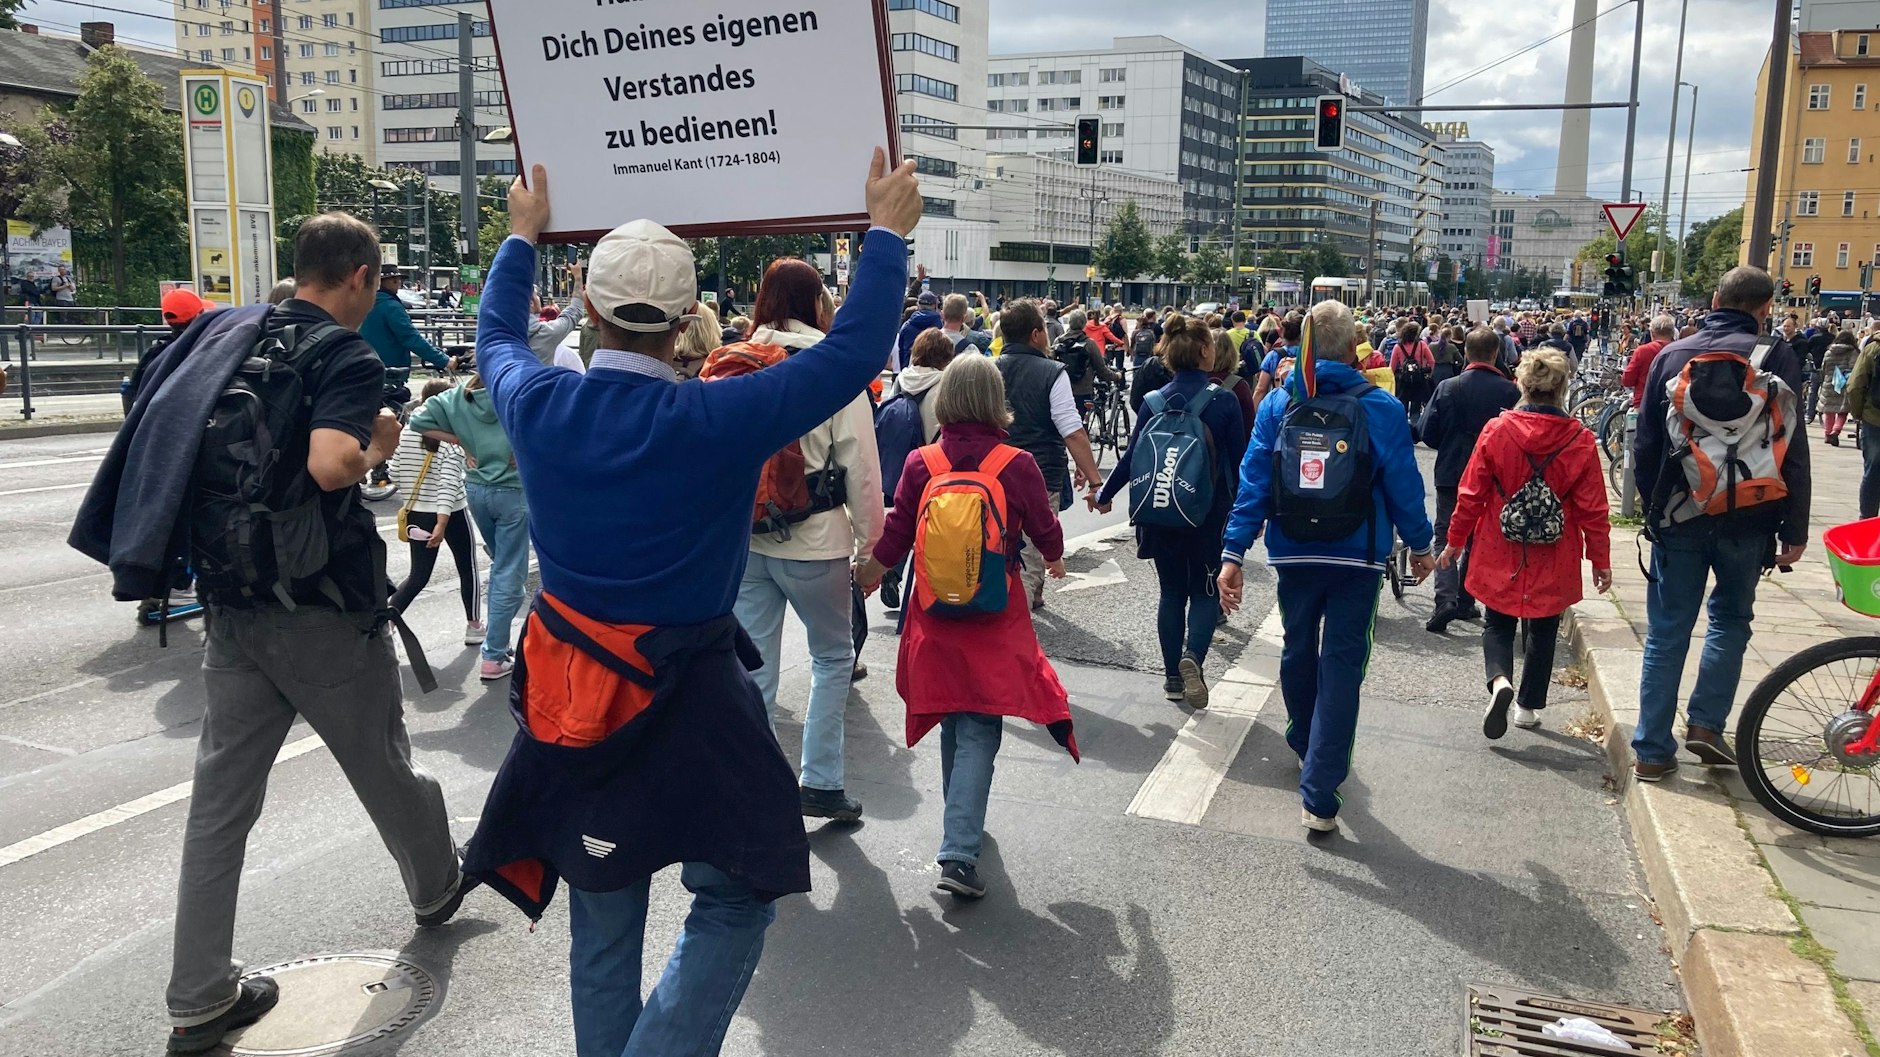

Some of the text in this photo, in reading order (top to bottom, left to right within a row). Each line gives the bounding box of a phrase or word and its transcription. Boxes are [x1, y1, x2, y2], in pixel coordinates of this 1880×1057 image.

[541, 9, 819, 62] Dich Deines eigenen
[602, 64, 755, 102] Verstandes
[200, 91, 213, 108] H
[605, 109, 778, 149] zu bedienen!
[612, 149, 781, 176] Immanuel Kant (1724-1804)
[12, 237, 68, 248] ACHIM BAYER
[253, 274, 261, 298] besser
[1152, 446, 1180, 509] Wilson
